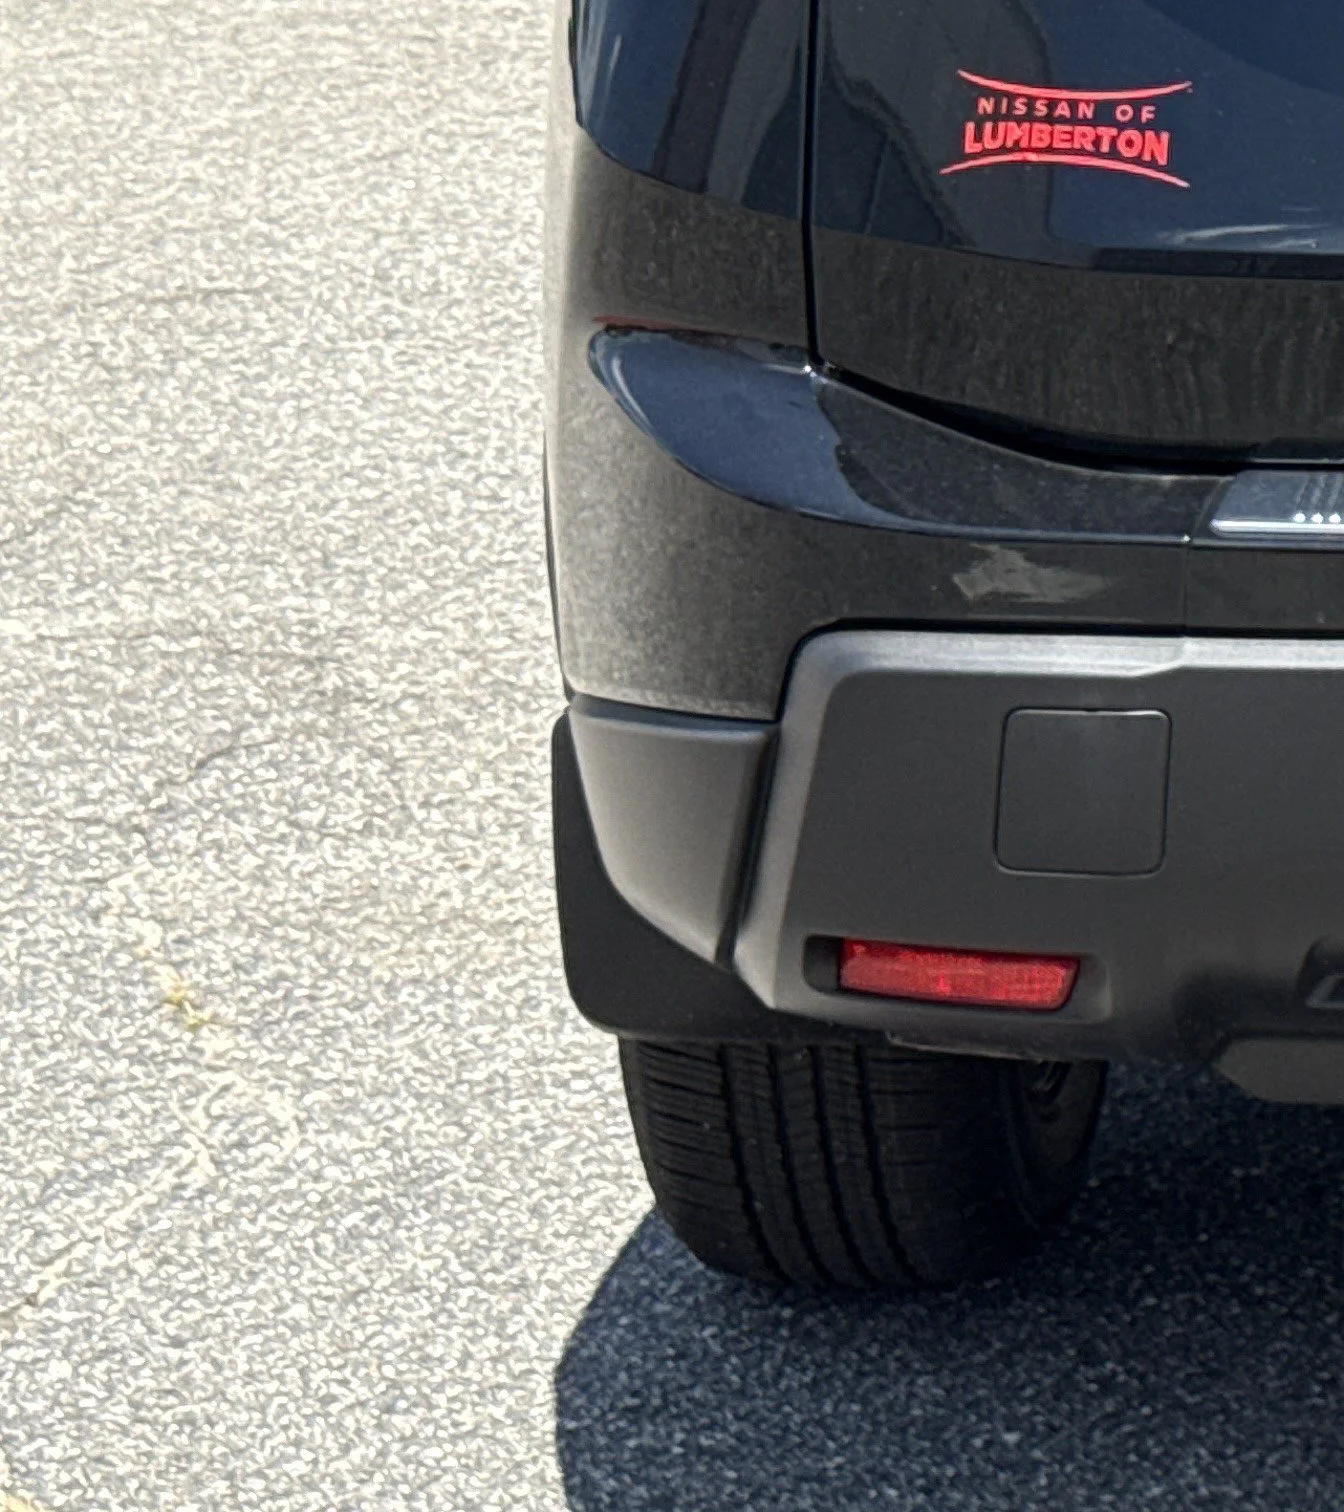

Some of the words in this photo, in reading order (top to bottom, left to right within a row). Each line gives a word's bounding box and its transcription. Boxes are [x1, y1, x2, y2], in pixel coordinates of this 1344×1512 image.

[977, 96, 1096, 120] NISSAN
[1115, 104, 1156, 124] OF
[964, 120, 1170, 166] LUMBERTON
